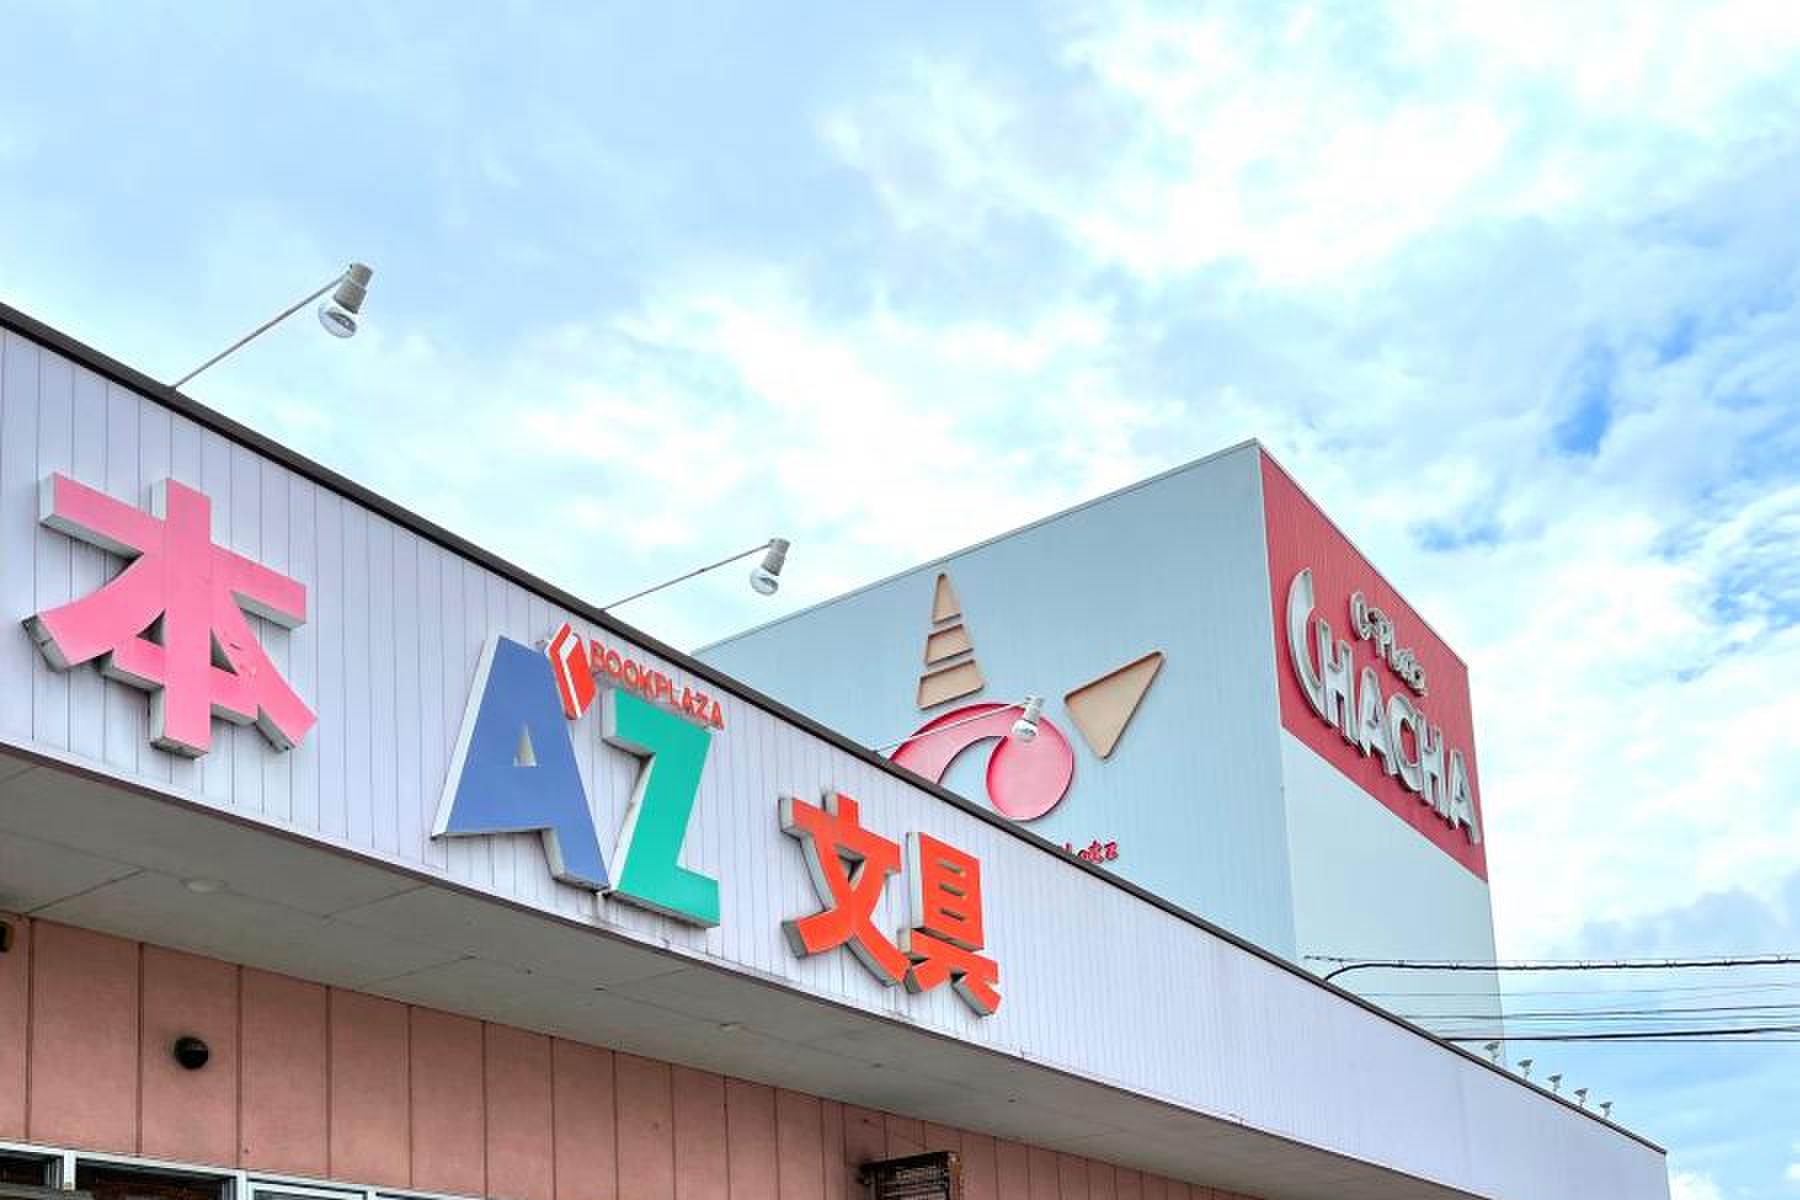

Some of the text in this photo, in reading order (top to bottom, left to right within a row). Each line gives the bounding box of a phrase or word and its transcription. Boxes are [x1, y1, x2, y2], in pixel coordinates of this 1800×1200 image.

[22, 472, 318, 757] 本
[1286, 568, 1482, 845] CHACHA
[780, 792, 1000, 1016] 文具
